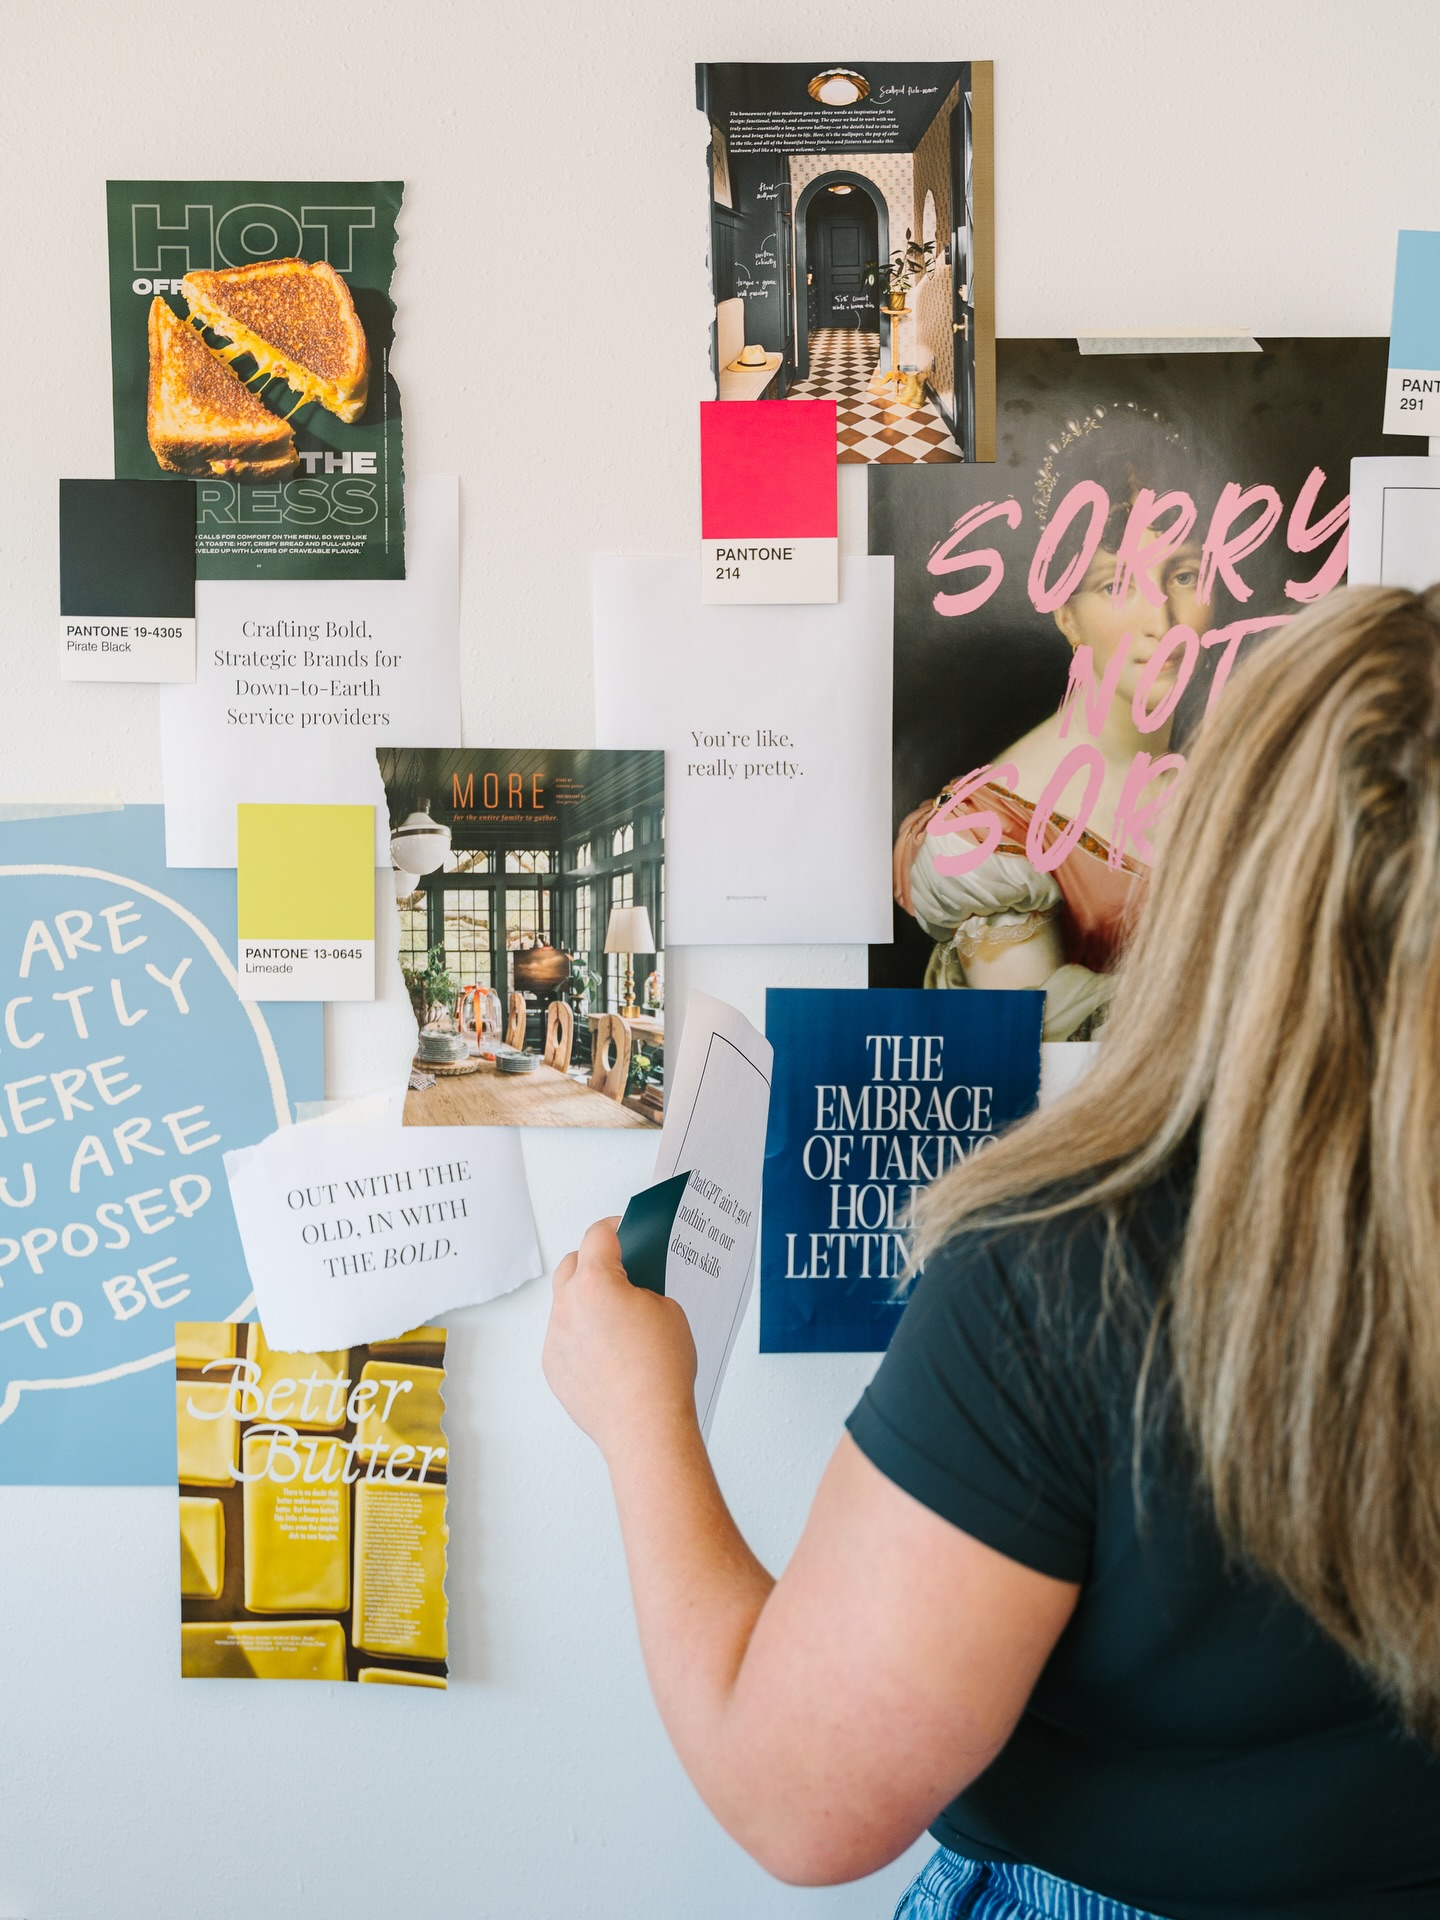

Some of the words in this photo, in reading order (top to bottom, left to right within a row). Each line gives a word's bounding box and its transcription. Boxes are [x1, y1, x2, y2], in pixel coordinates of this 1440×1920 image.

[132, 203, 376, 272] HOT
[132, 278, 184, 295] OFF
[1400, 398, 1423, 410] 291
[1402, 378, 1440, 393] PANT
[298, 452, 377, 474] THE
[188, 478, 378, 525] RESS
[716, 548, 793, 561] PANTONE
[926, 466, 1350, 616] SORRY
[716, 567, 740, 580] 214
[66, 626, 129, 638] PANTONE
[133, 627, 182, 638] 19-4305
[66, 641, 97, 652] Pirate
[101, 641, 131, 653] Black
[242, 620, 319, 641] Crafting
[325, 620, 373, 639] Bold,
[214, 650, 297, 670] Strategic
[302, 650, 369, 668] Brands
[374, 650, 402, 668] for
[1058, 614, 1300, 739] NOT
[235, 679, 381, 697] Down-to-Earth
[227, 708, 295, 726] Service
[300, 708, 390, 728] providers
[691, 731, 750, 748] You're
[756, 730, 794, 750] like,
[453, 772, 544, 809] MORE
[687, 760, 738, 779] really
[744, 760, 804, 779] pretty.
[926, 744, 1187, 878] SOR
[19, 901, 148, 978] ARE
[246, 949, 308, 959] PANTONE
[314, 949, 362, 959] 13-0645
[246, 964, 293, 973] Limeade
[1, 957, 192, 1048] CTLY
[866, 1036, 944, 1081] THE
[0, 1056, 142, 1137] ERE
[814, 1085, 993, 1132] EMBRACE
[70, 1105, 221, 1193] ARE
[803, 1135, 853, 1180] OF
[287, 1184, 338, 1210] OUT
[345, 1171, 413, 1200] WITH
[418, 1160, 472, 1189] THE
[687, 1168, 722, 1204] ChatGPT
[719, 1194, 739, 1217] ain't
[735, 1207, 752, 1227] got
[0, 1174, 212, 1287] PPOSED
[302, 1218, 361, 1245] OLD,
[367, 1212, 394, 1235] IN
[400, 1198, 469, 1227] WITH
[679, 1206, 710, 1233] nothin'
[708, 1225, 720, 1242] on
[720, 1232, 735, 1251] our
[323, 1251, 376, 1279] THE
[383, 1238, 457, 1269] BOLD.
[671, 1234, 699, 1265] design
[699, 1252, 721, 1278] skills
[784, 1233, 924, 1279] LETTIN
[0, 1301, 83, 1349] TO
[102, 1256, 191, 1320] BE
[186, 1358, 413, 1423] Better
[228, 1424, 447, 1485] Butter
